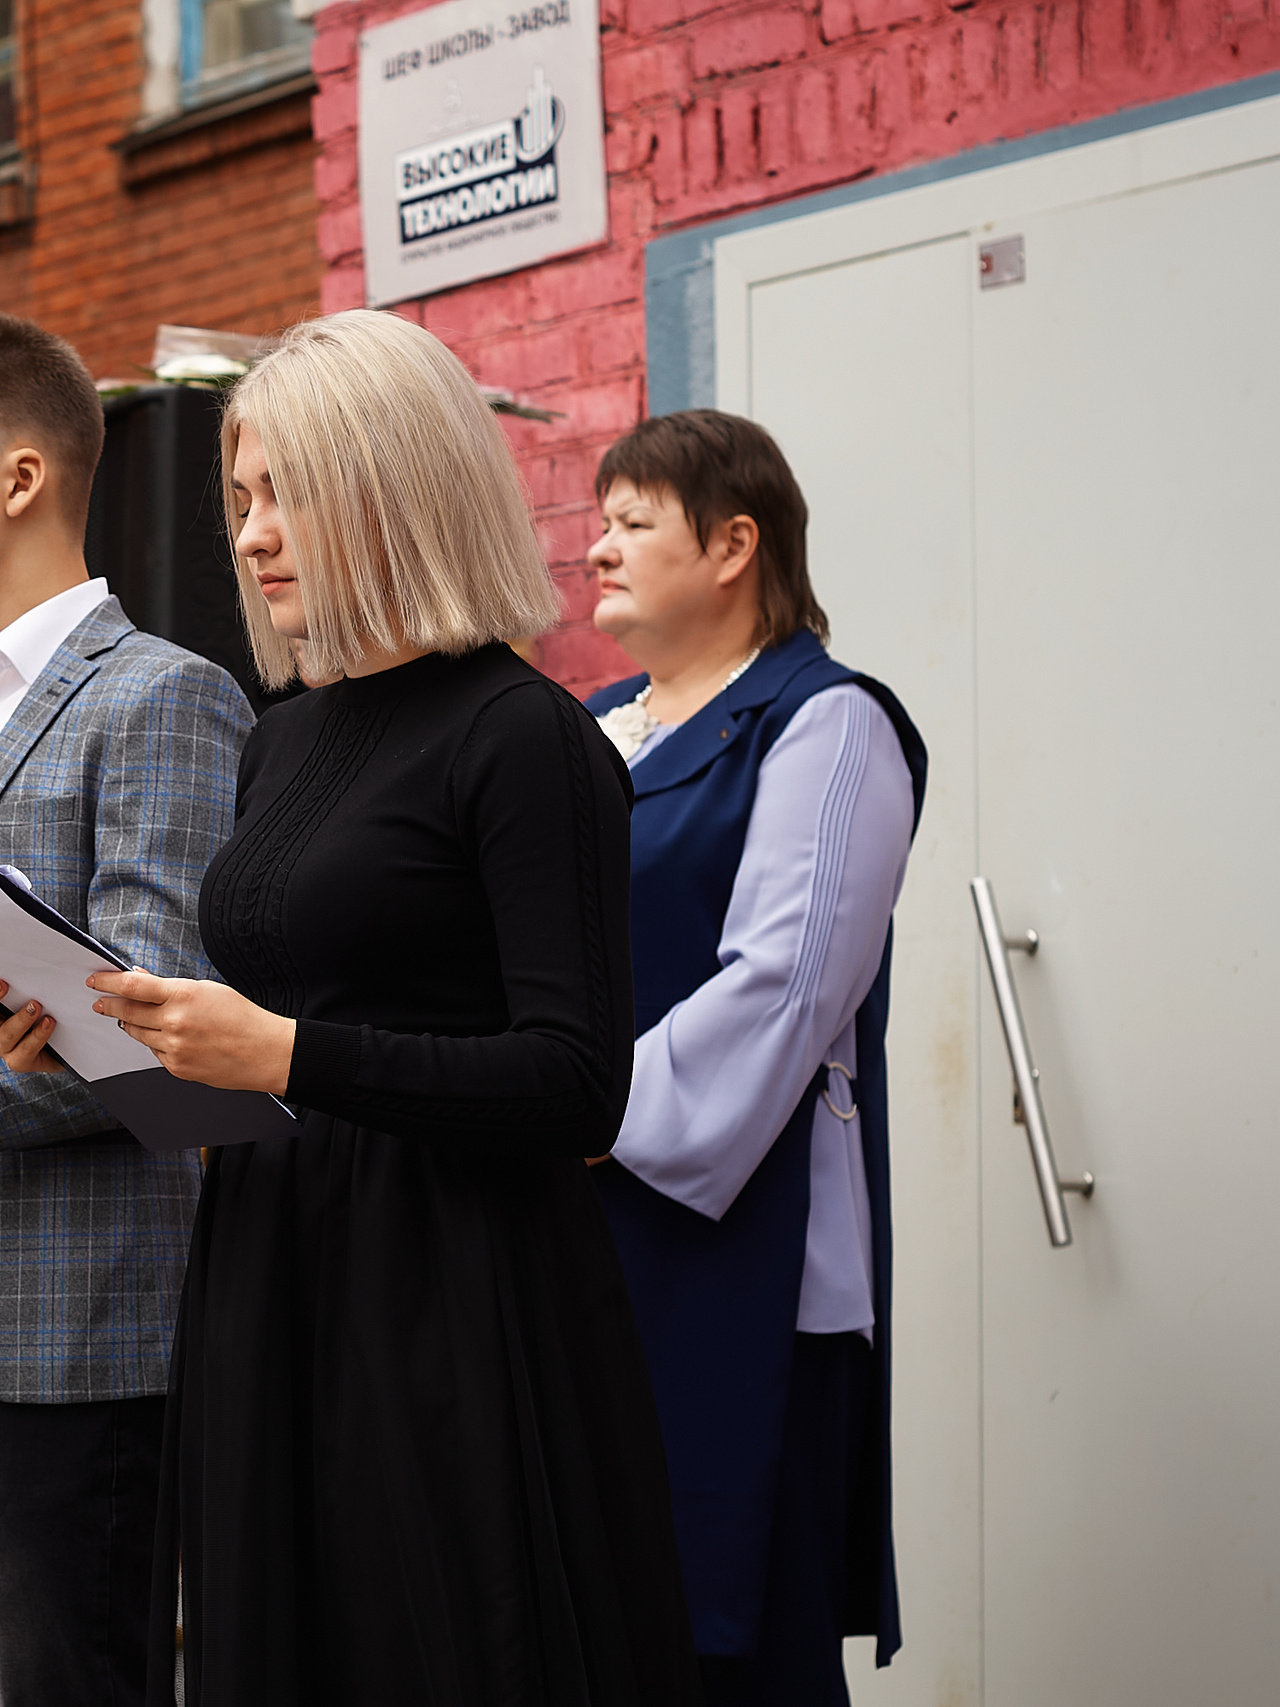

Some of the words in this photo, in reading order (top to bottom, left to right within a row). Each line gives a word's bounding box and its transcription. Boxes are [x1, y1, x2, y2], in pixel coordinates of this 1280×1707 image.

[384, 49, 422, 80] ШЕФ
[427, 24, 494, 66] ШКОЛЫ
[508, 0, 570, 39] ЗАВОД
[403, 133, 507, 189] ВЫСОКИЕ
[403, 163, 556, 238] ТЕХНОЛОГИИ
